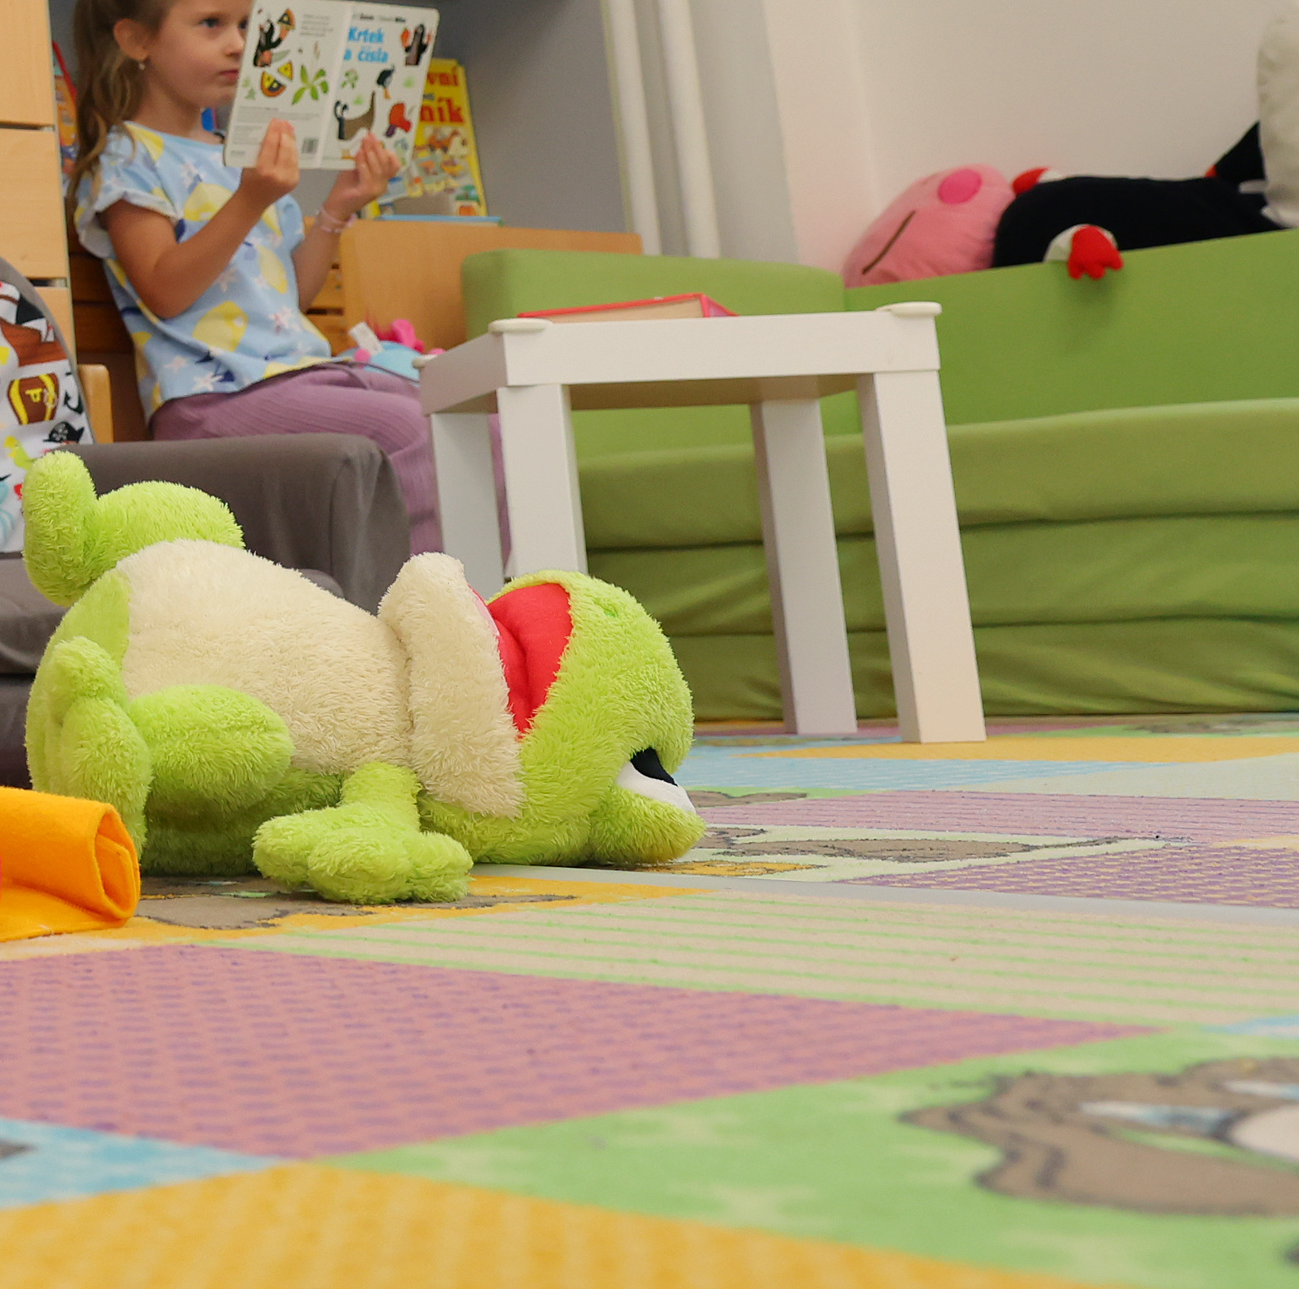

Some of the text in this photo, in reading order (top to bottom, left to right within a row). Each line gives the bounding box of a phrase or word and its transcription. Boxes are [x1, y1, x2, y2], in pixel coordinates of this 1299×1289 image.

[348, 26, 384, 43] Krtek
[343, 48, 353, 62] a
[427, 66, 458, 86] vní
[419, 96, 464, 123] ník
